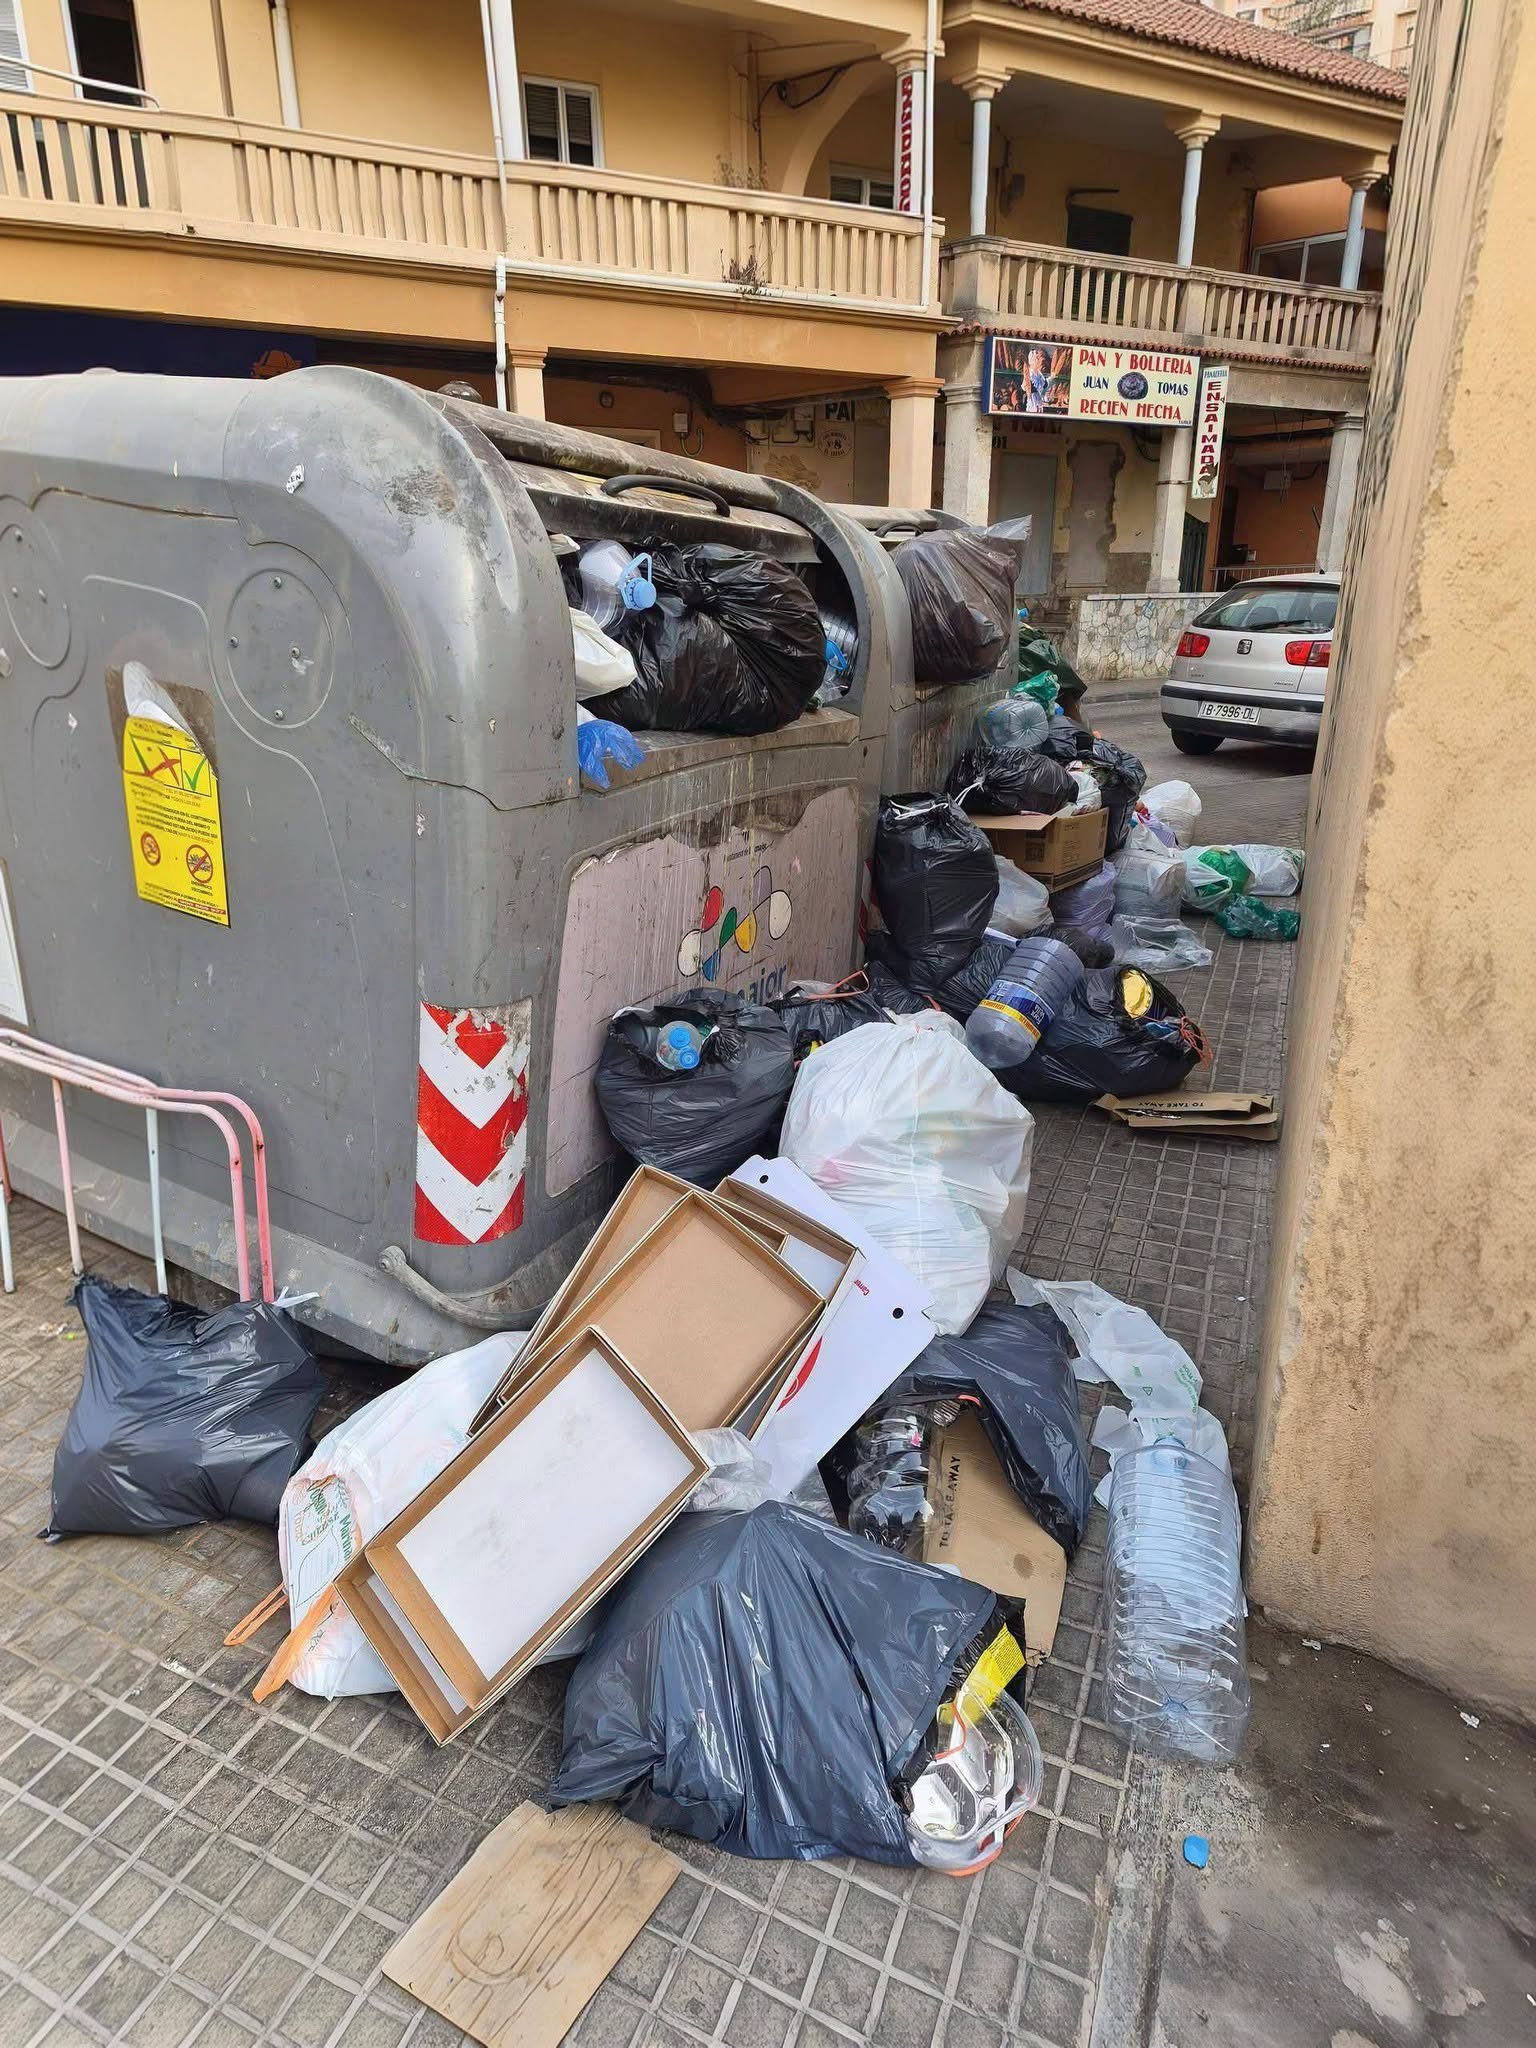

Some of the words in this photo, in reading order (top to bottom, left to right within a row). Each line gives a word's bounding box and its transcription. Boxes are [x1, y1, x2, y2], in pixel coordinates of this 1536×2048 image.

[1079, 349, 1106, 368] PAN
[1114, 353, 1123, 370] Y
[1130, 356, 1193, 376] BOLLERIA
[1083, 376, 1110, 390] JUAN
[1157, 382, 1189, 396] TOMAS
[1080, 399, 1129, 417] RECIEN
[1136, 402, 1182, 420] HECHA
[948, 1456, 961, 1490] AWAY
